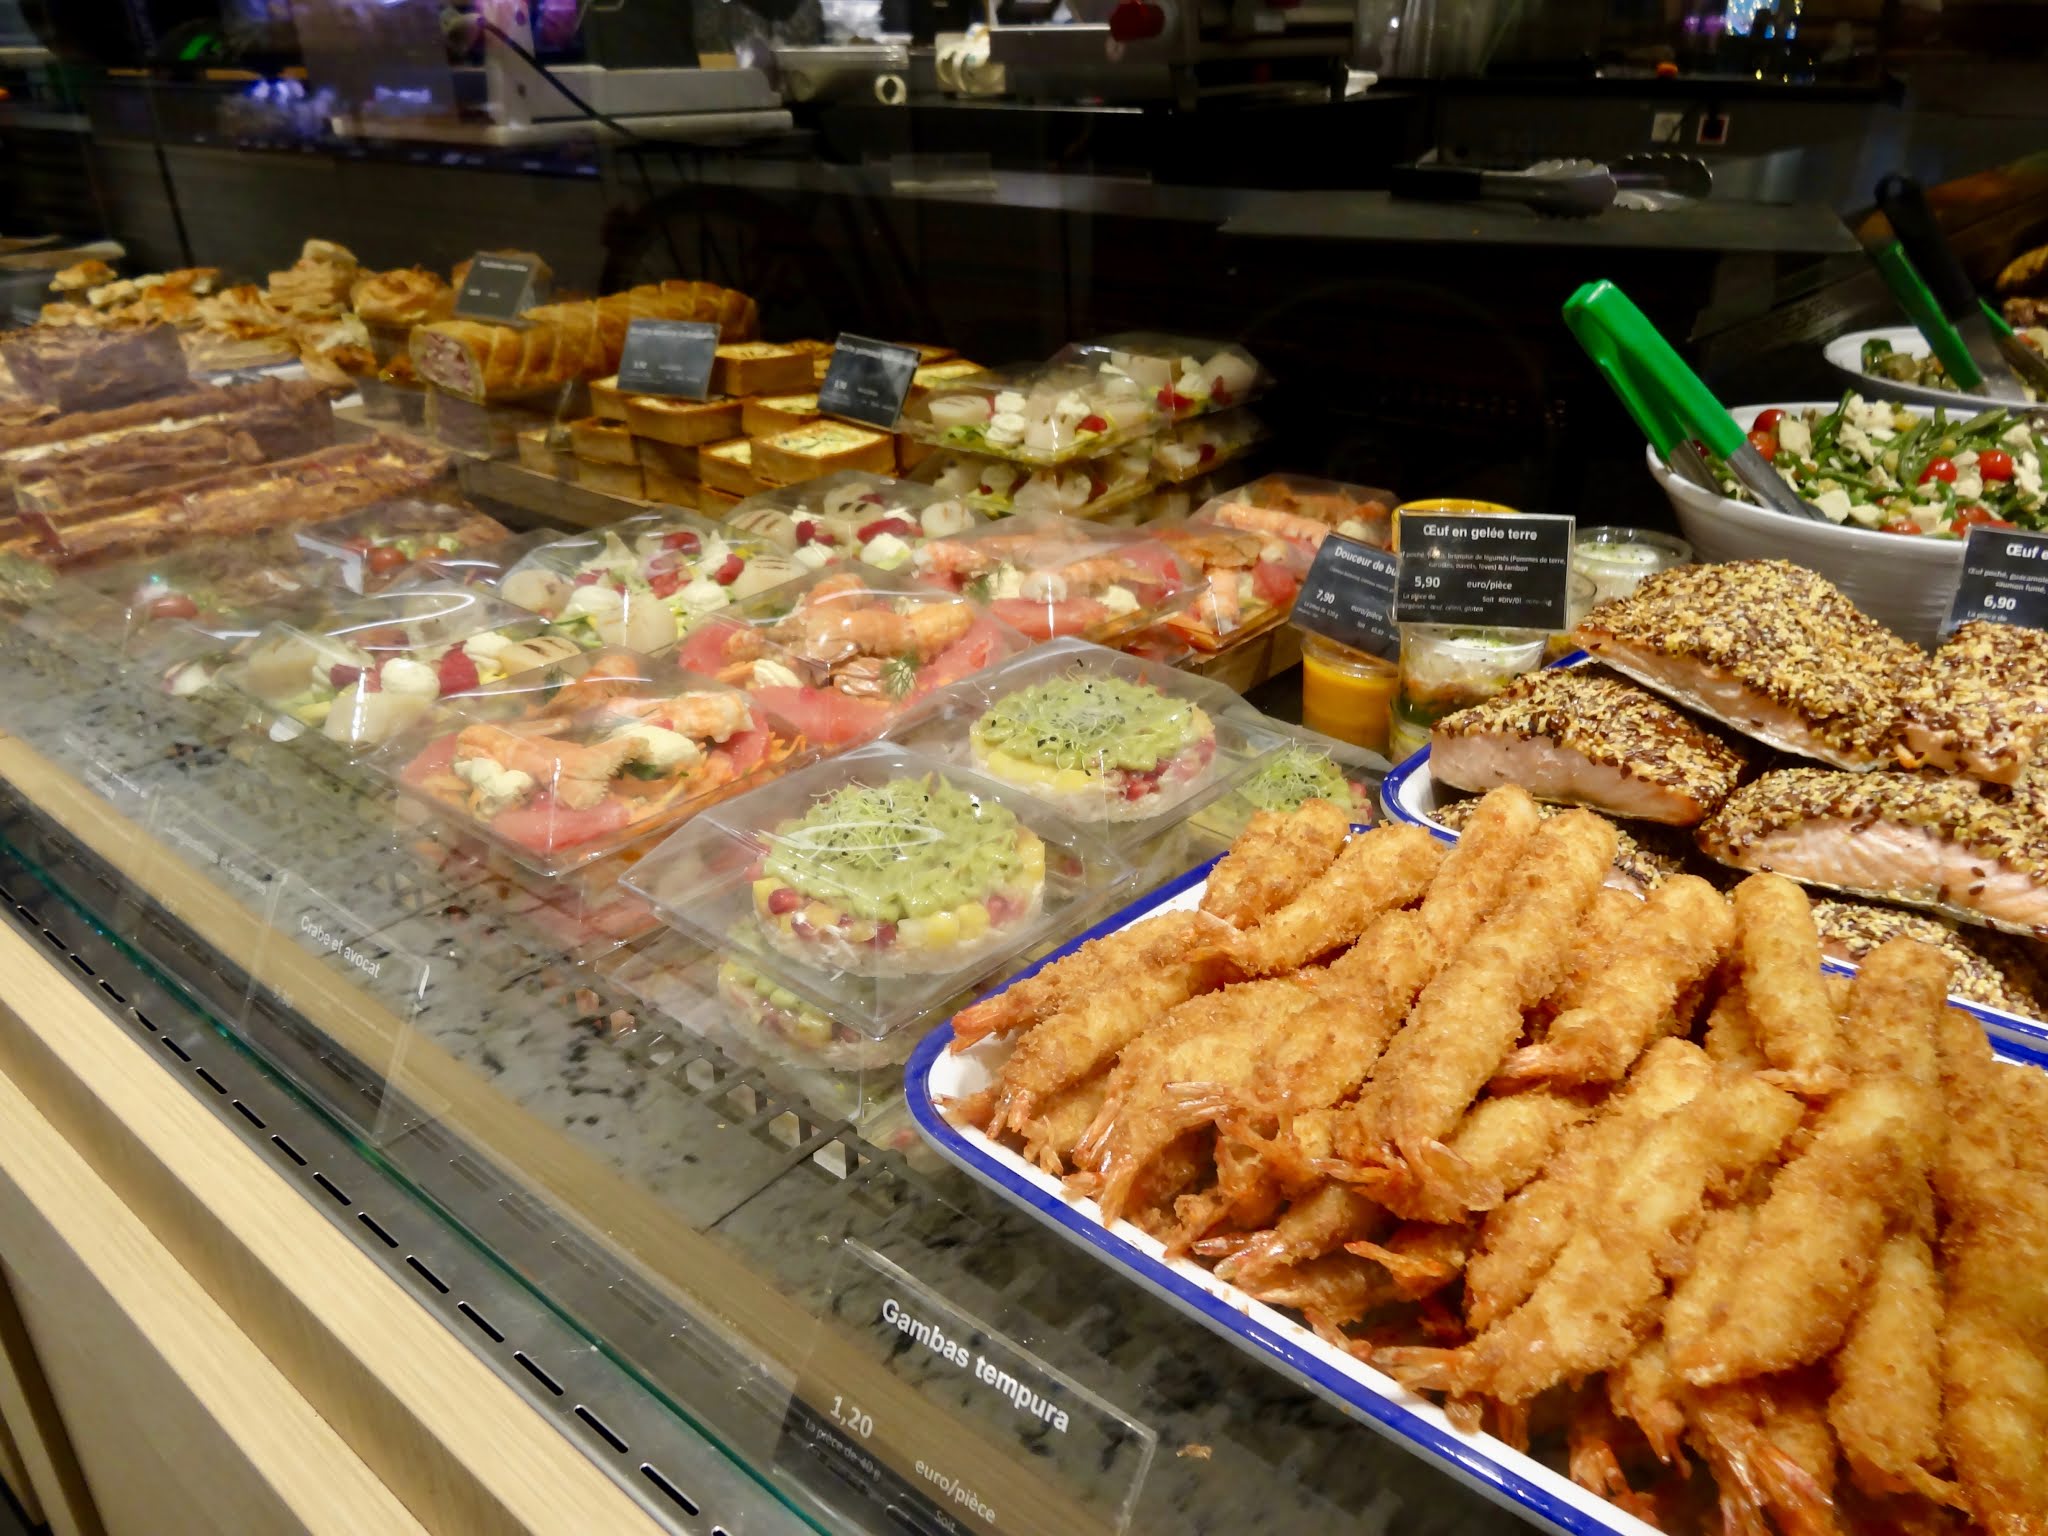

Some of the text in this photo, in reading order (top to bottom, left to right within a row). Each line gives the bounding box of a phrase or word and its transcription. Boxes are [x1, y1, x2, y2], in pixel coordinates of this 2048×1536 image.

[1423, 524, 1538, 541] Œuf en gelée terre
[1335, 545, 1372, 567] Douceur
[1373, 560, 1385, 572] de
[2006, 543, 2039, 559] Œuf
[1414, 576, 1513, 591] 5,90 euro/pièce
[1316, 588, 1335, 604] 7,90
[1984, 595, 2016, 610] 6,90
[301, 915, 381, 979] Crabe et avocat
[881, 1297, 1070, 1434] Gambas tempura
[830, 1395, 873, 1438] 1,20
[915, 1460, 996, 1524] euro/pièce
